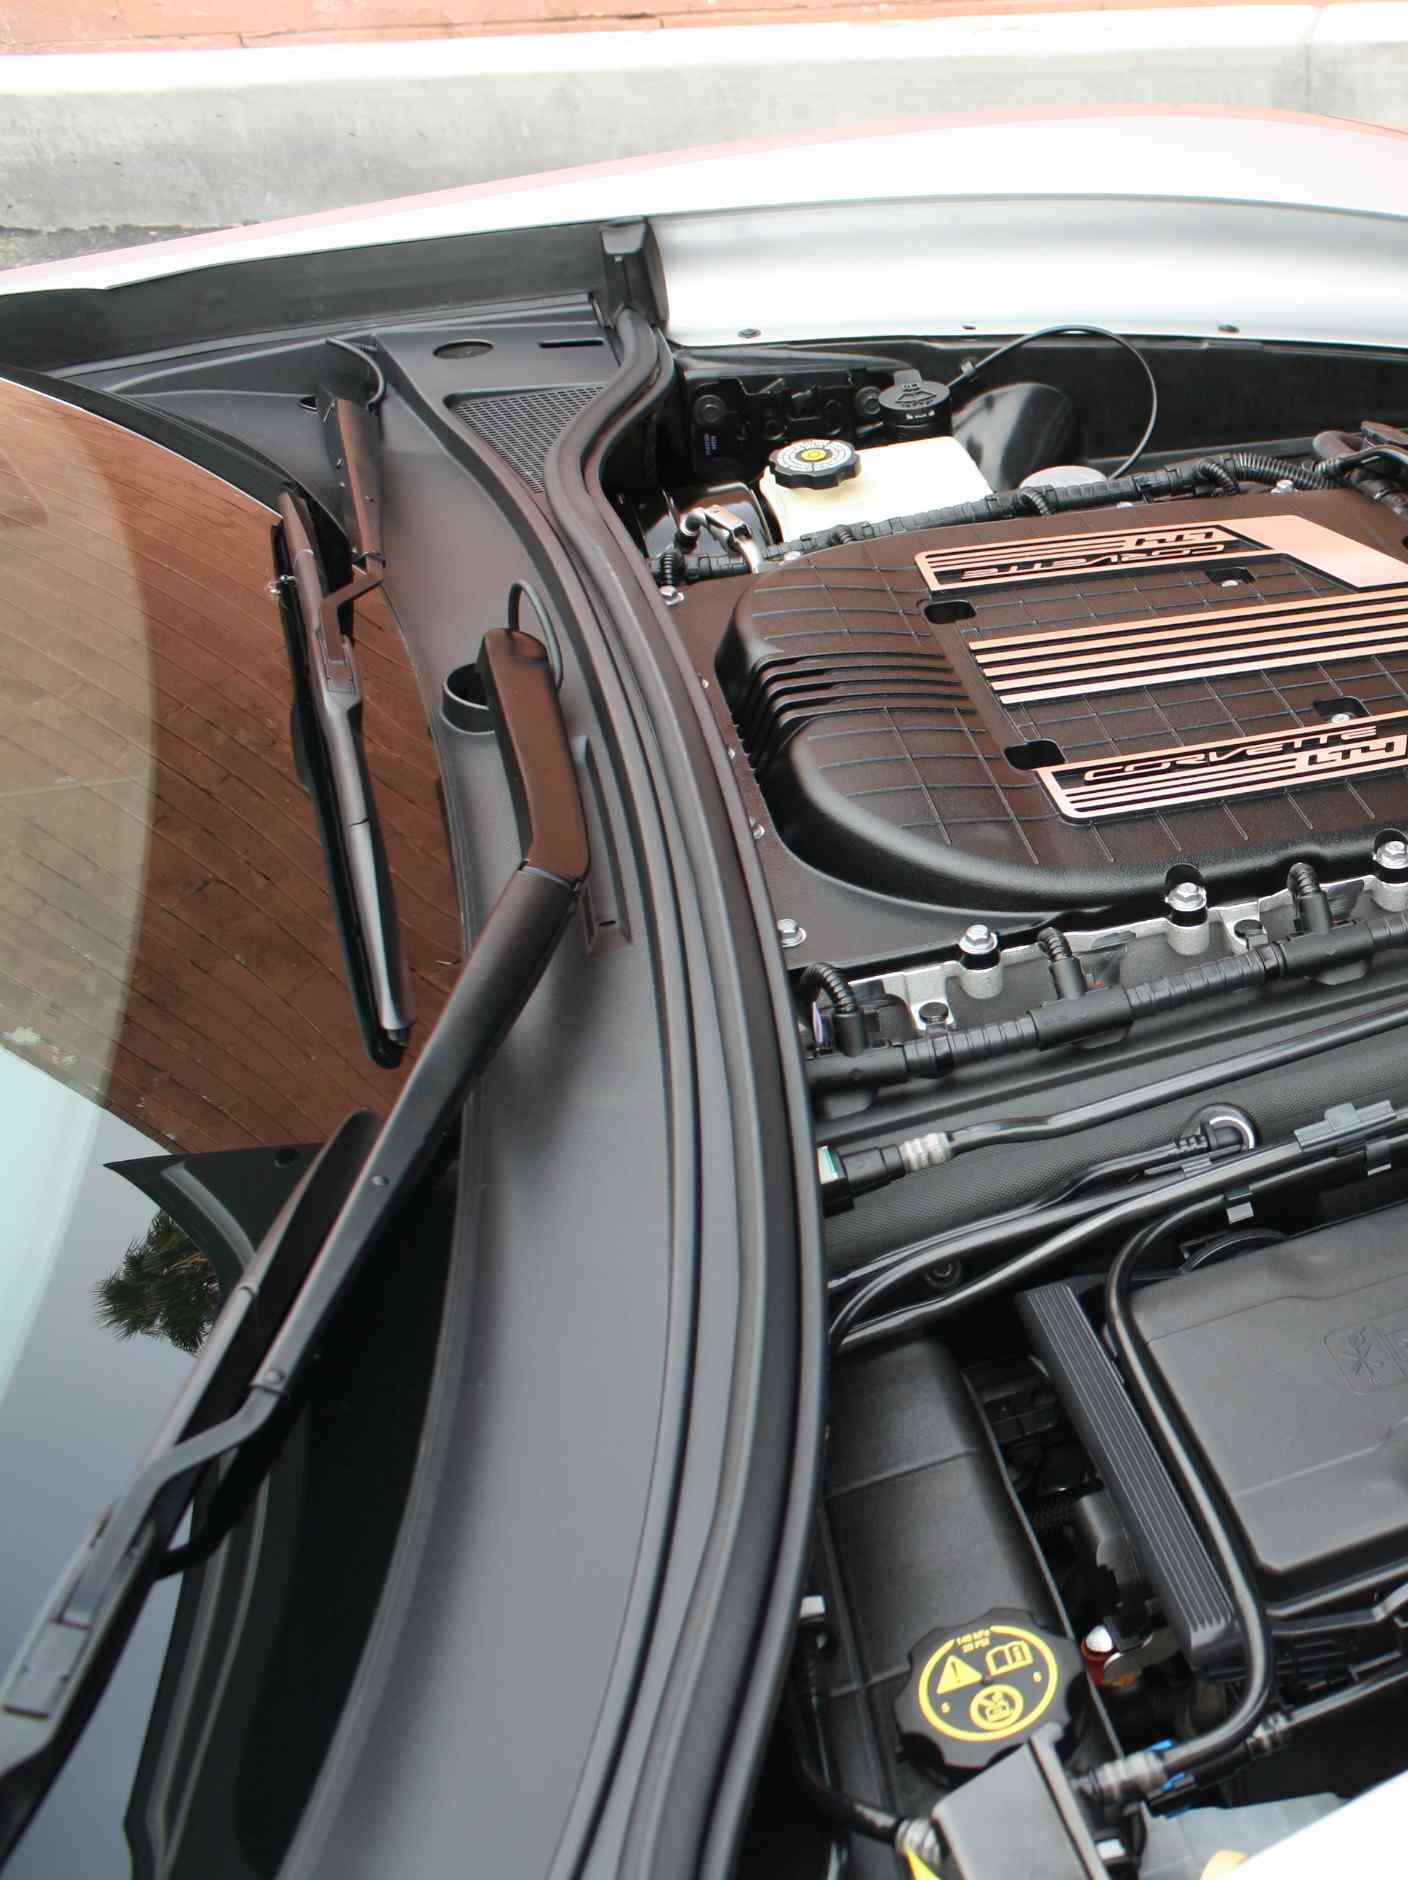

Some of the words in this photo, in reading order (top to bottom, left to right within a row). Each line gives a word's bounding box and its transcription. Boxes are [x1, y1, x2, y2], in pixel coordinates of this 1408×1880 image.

[961, 543, 1225, 579] CORVETTE
[1083, 725, 1377, 781] CORVETTE
[1304, 739, 1398, 768] LT4
